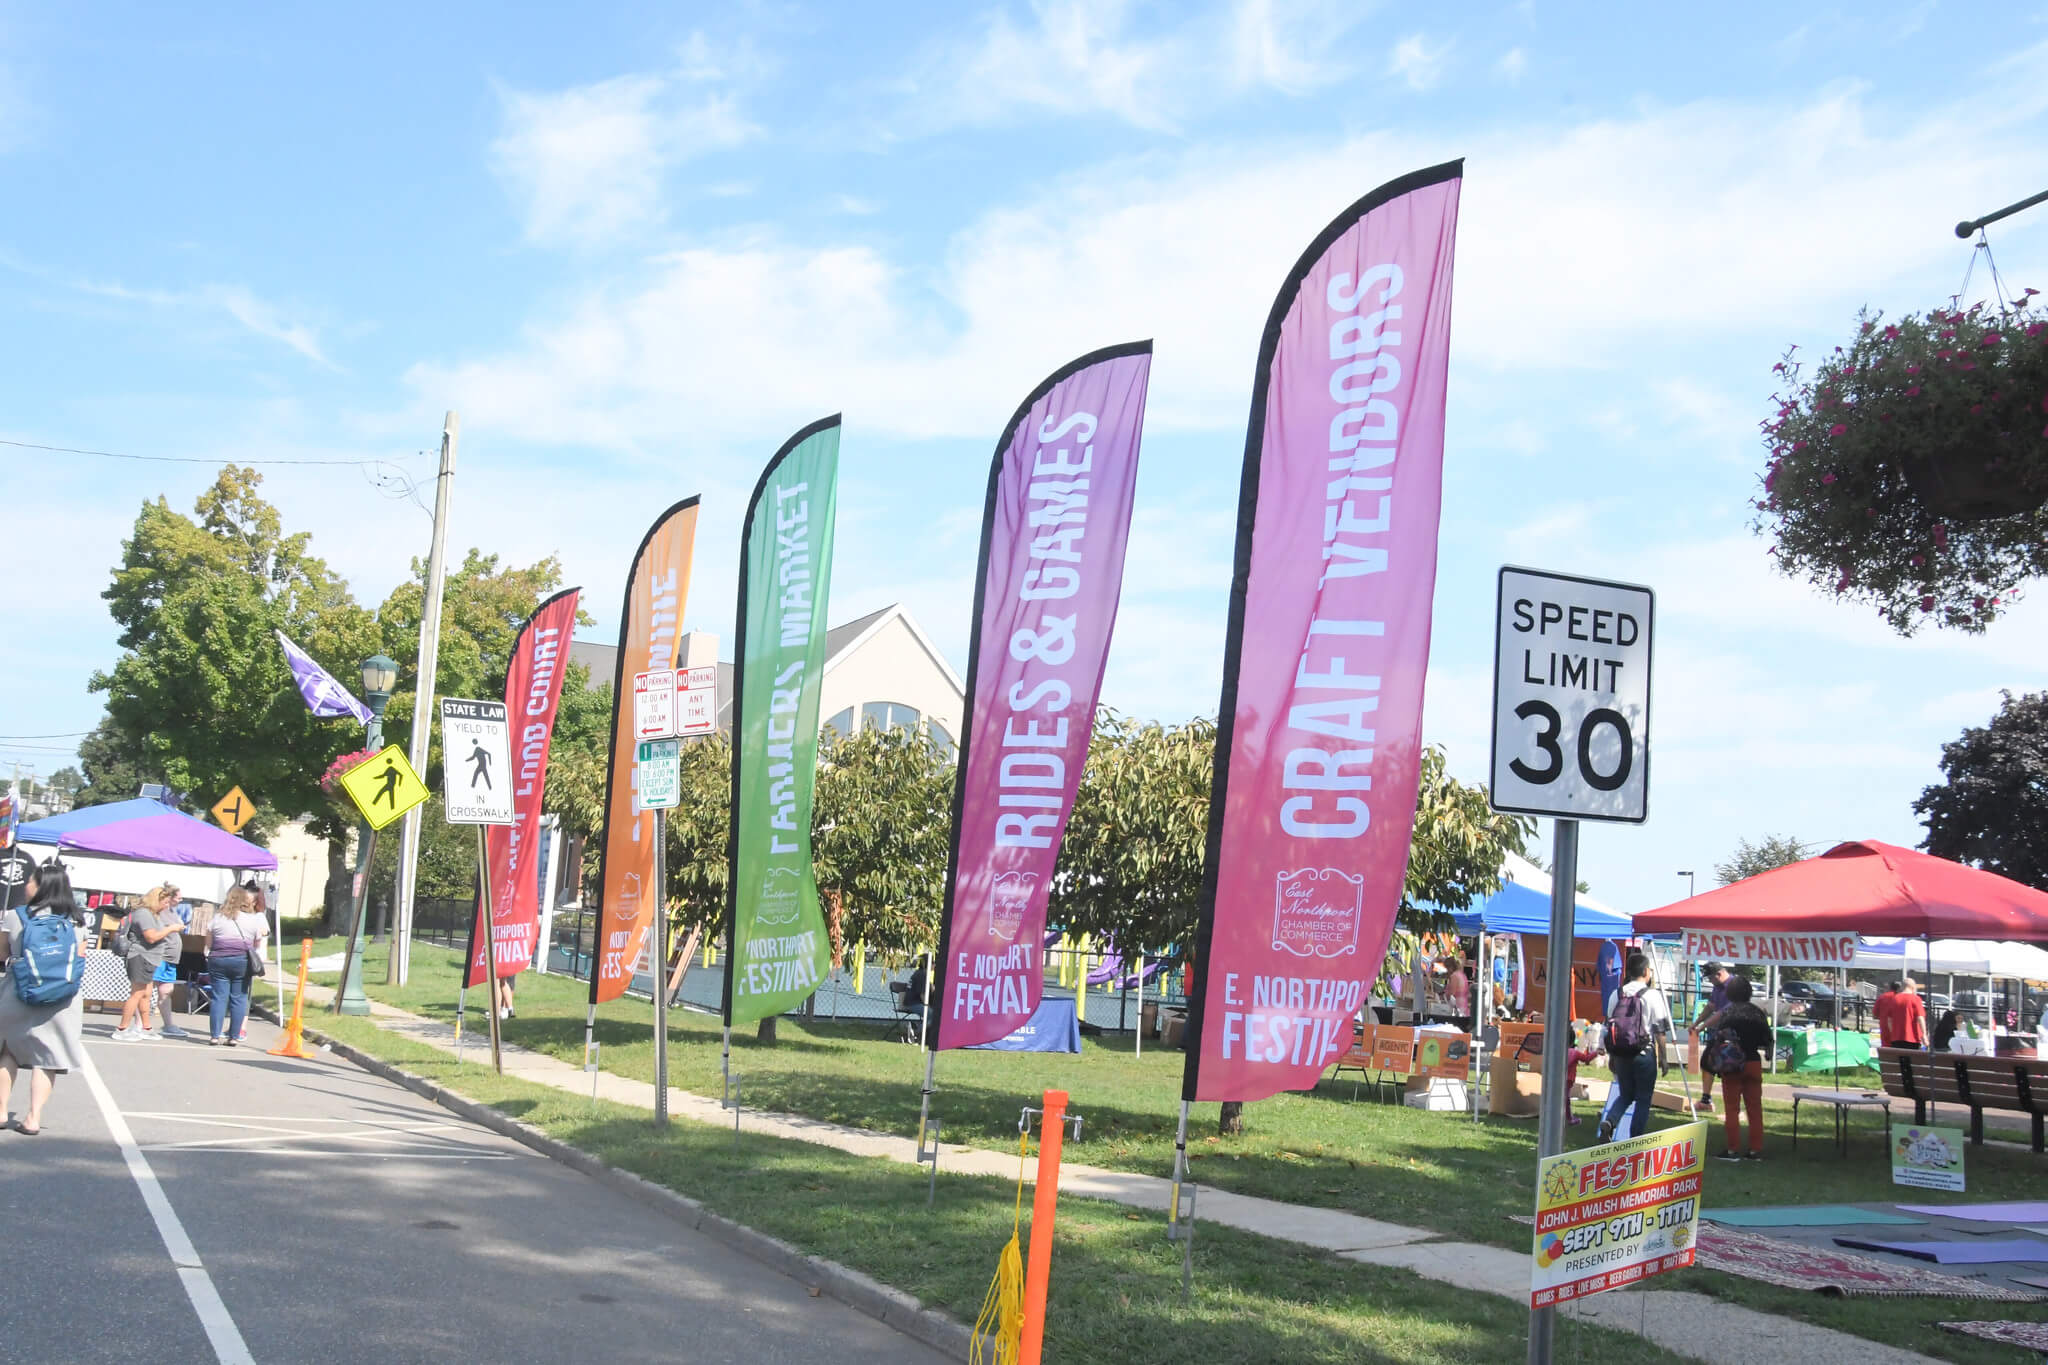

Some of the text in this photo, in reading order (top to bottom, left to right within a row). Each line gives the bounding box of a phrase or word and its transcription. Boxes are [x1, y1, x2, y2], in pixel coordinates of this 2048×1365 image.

[1318, 263, 1405, 592] VENDORS
[1019, 411, 1098, 601] GAMES
[1512, 598, 1640, 647] SPEED
[1009, 613, 1077, 665] &
[526, 627, 560, 716] COURT
[636, 677, 671, 690] NO PARKING
[677, 672, 713, 687] NO PARKING
[1524, 648, 1624, 694] LIMIT
[444, 703, 504, 718] STATE LAW
[688, 707, 705, 717] TIME
[689, 695, 704, 704] ANY
[454, 722, 499, 735] YIELD TO
[1508, 700, 1633, 791] 30
[995, 680, 1072, 849] RIDES
[450, 806, 511, 819] CROSSWALK
[476, 794, 486, 804] IN
[1285, 881, 1314, 898] East
[1282, 899, 1354, 919] Northport
[1280, 930, 1344, 942] COMMERCE
[1281, 919, 1353, 931] CHAMBER OF
[1686, 932, 1854, 962] FACE PAINTING
[1225, 972, 1365, 1012] E. NORTHPO
[1222, 1011, 1344, 1067] FESTIV
[1590, 1135, 1663, 1158] EAST NORTHPORT
[1577, 1138, 1698, 1198] FESTIVAL
[1540, 1177, 1698, 1229] JOHN J. WALSH MEMORIAL PARK
[1562, 1222, 1607, 1255] SEPT
[1608, 1211, 1645, 1242] 9TH
[1566, 1243, 1640, 1273] PRESENTED BY
[1536, 1290, 1555, 1305] GAMES
[1578, 1281, 1590, 1295] LIVE
[1590, 1277, 1606, 1291] MUSIC
[1609, 1271, 1623, 1286] BEER
